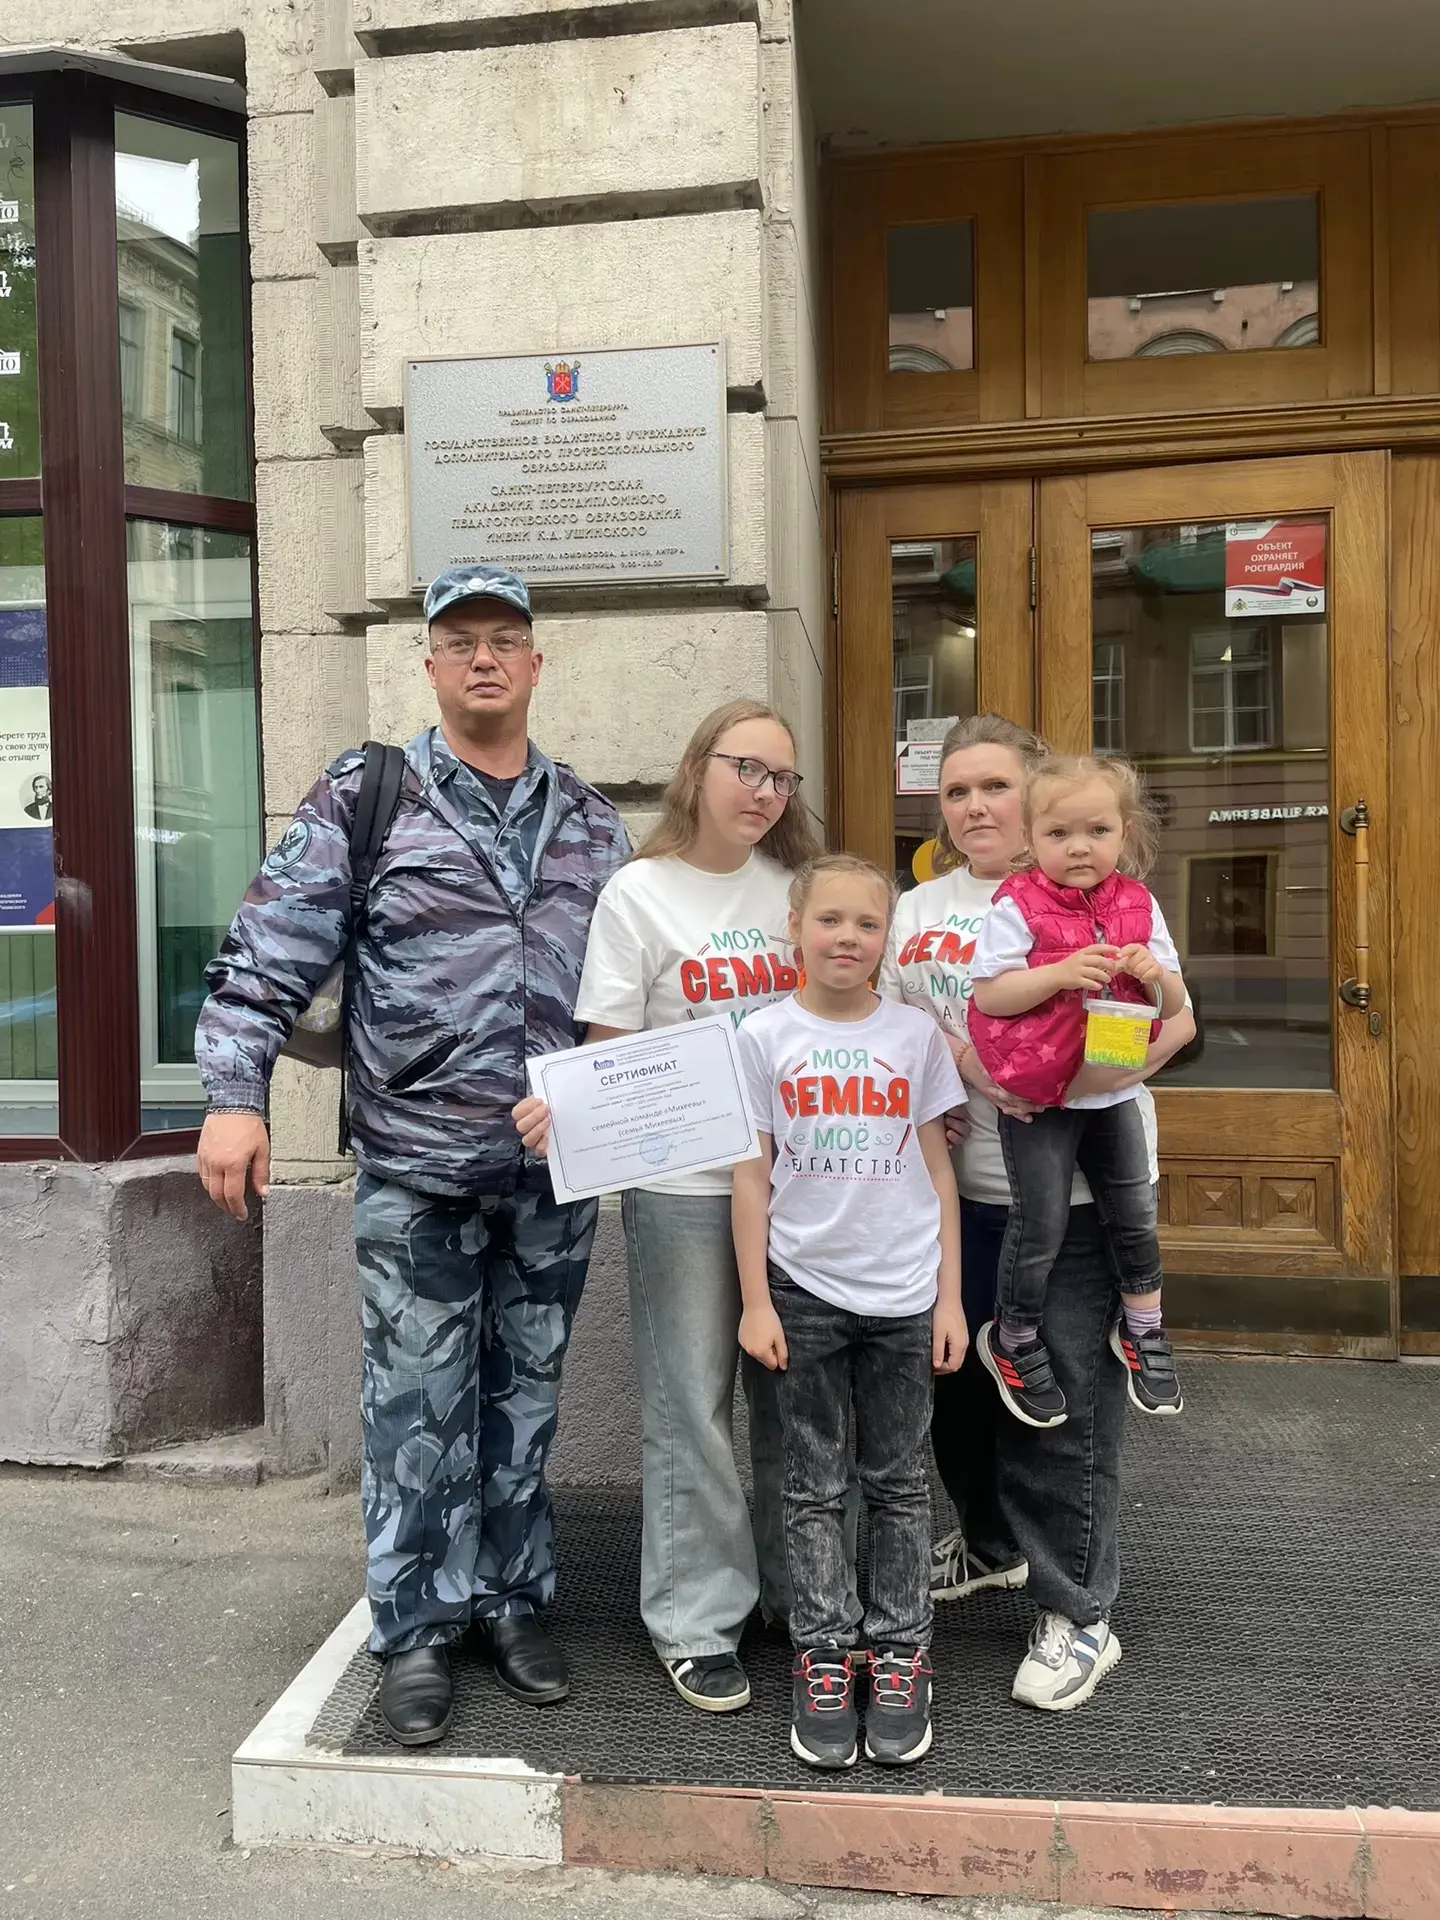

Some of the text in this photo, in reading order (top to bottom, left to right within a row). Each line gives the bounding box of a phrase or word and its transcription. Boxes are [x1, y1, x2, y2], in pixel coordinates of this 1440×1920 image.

[424, 426, 707, 450] ГОСУДАРСТВЕННОЕ БЮДЖЕТНОЕ УЧРЕЖДЕНИЕ
[434, 441, 695, 465] ДОПОЛНИТЕЛЬНОГО ПРОФЕССИОНАЛЬНОГО
[521, 460, 607, 474] ОБРАЗОВАНИЯ
[490, 479, 643, 496] САНКТ-ПЕТЕРБУРГСКАЯ
[463, 493, 667, 513] АКАДЕМИЯ ПОСТДИПЛОМНОГО
[451, 508, 682, 529] ПЕДАГОГИЧЕСКОГО ОБРАЗОВАНИЯ
[486, 530, 531, 543] ИМЕНИ
[564, 525, 647, 540] УШИНСКОГО
[1256, 542, 1293, 551] ОБЪЕКТ
[1250, 552, 1298, 562] ОХРАНЯЕТ
[1244, 562, 1305, 573] РОСГВАРДИЯ
[26, 732, 46, 740] труд
[8, 754, 40, 762] отыщет
[946, 914, 984, 934] МО
[711, 928, 767, 951] МОЯ
[898, 930, 977, 967] СЕМ
[680, 952, 800, 1004] СЕМЬ
[811, 1048, 869, 1070] МОЯ
[600, 1060, 678, 1087] СЕРТИФИКАТ
[779, 1075, 910, 1119] СЕМЬЯ
